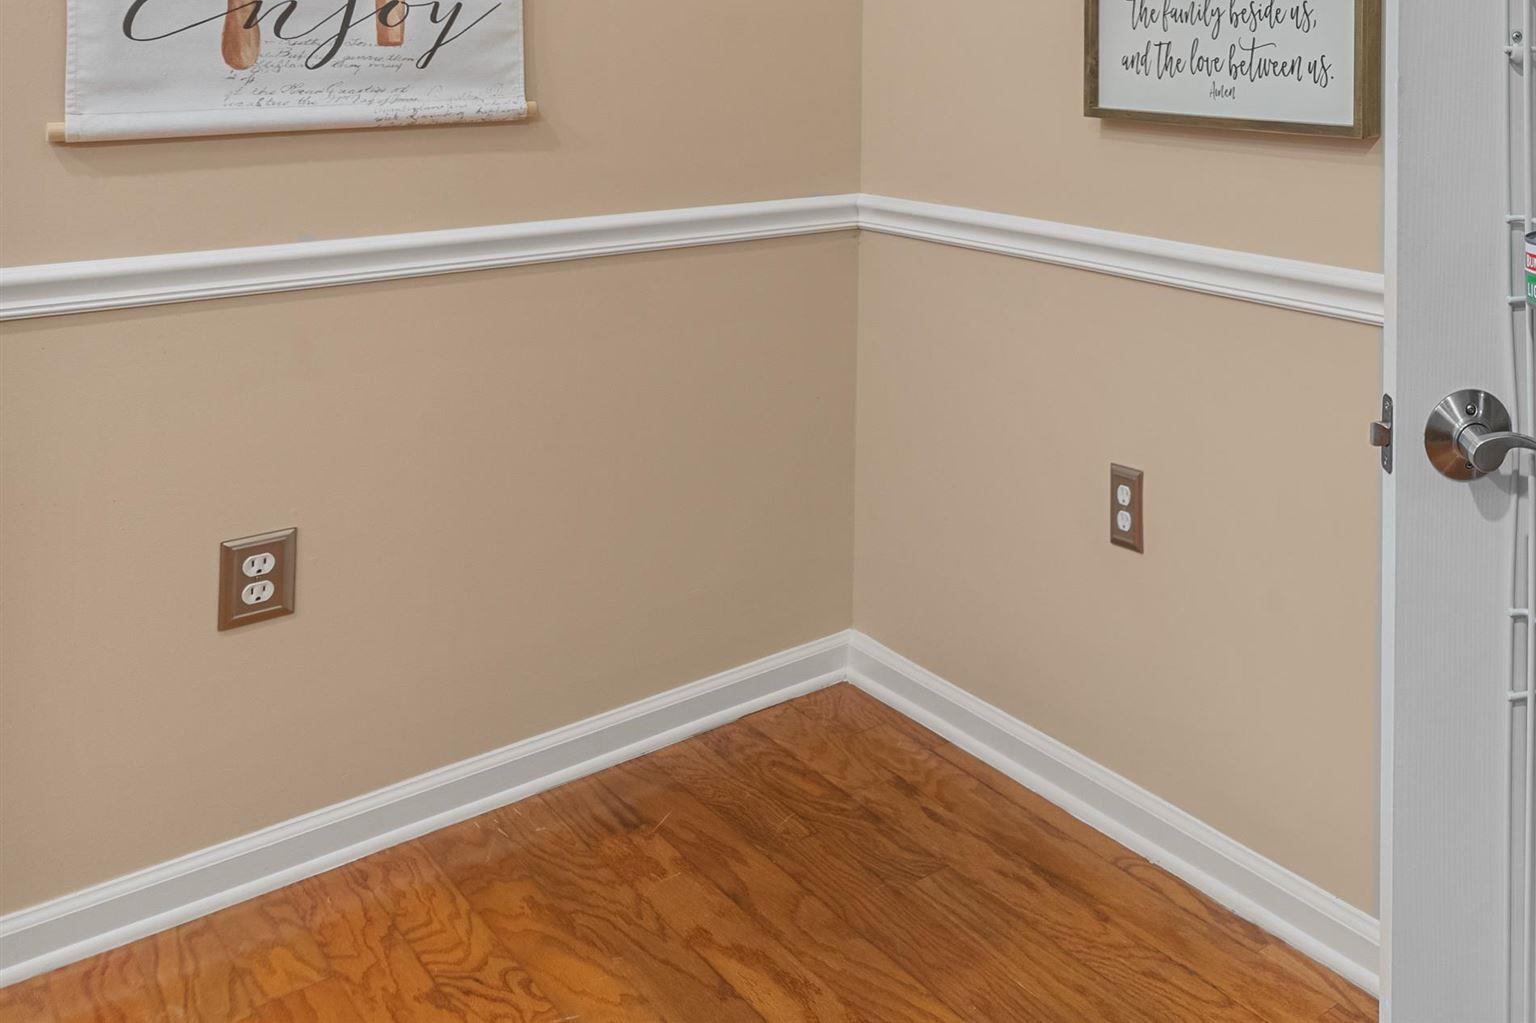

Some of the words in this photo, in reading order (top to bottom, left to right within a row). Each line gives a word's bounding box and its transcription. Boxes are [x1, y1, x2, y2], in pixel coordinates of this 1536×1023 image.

[1290, 0, 1317, 33] us,
[1121, 40, 1151, 76] and
[1154, 40, 1185, 79] the
[1190, 37, 1225, 76] love
[1228, 36, 1304, 82] between
[1307, 53, 1335, 88] us.
[1209, 81, 1236, 100] Amen
